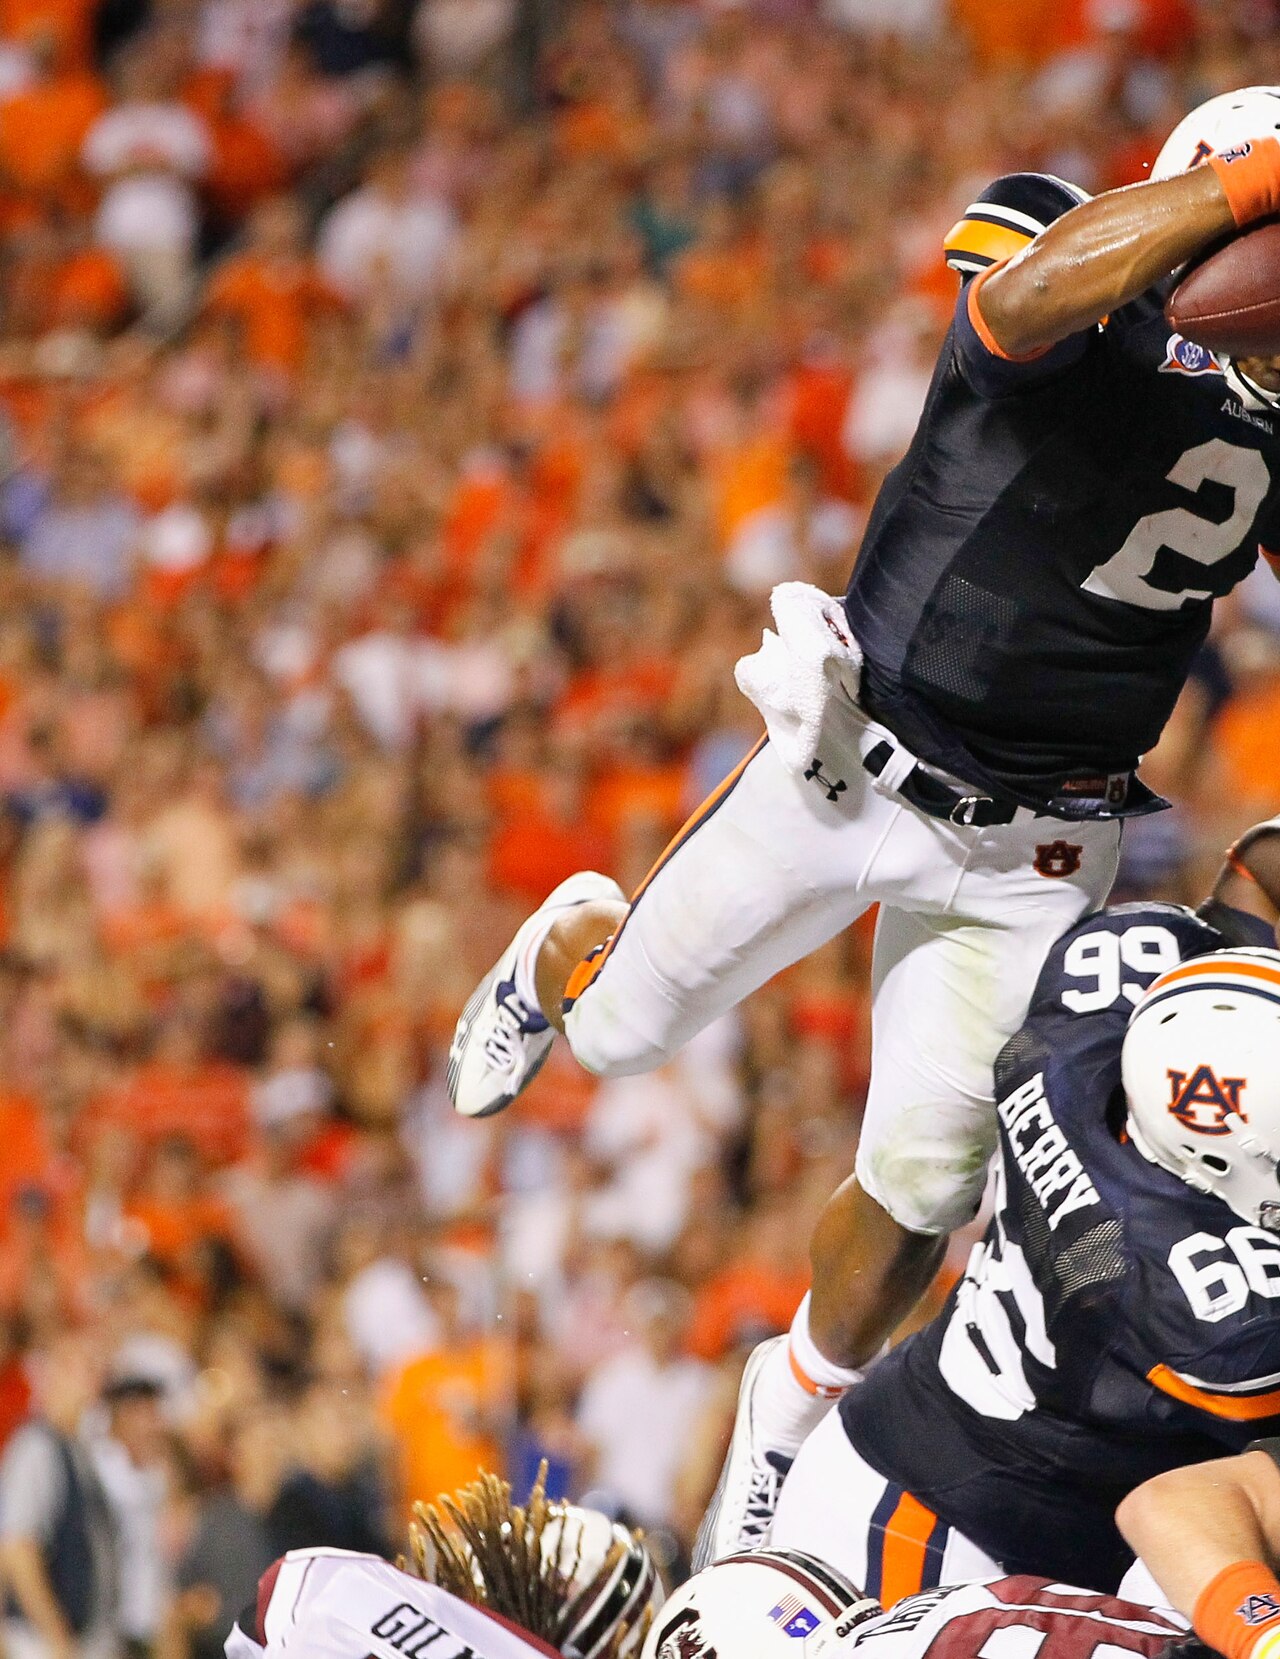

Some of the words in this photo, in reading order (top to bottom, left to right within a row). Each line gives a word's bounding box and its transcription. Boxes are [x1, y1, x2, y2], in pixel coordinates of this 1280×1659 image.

[1220, 398, 1275, 436] AUBURN
[1080, 436, 1272, 612] 2
[997, 1072, 1101, 1231] BERRY
[1166, 1065, 1250, 1135] AU
